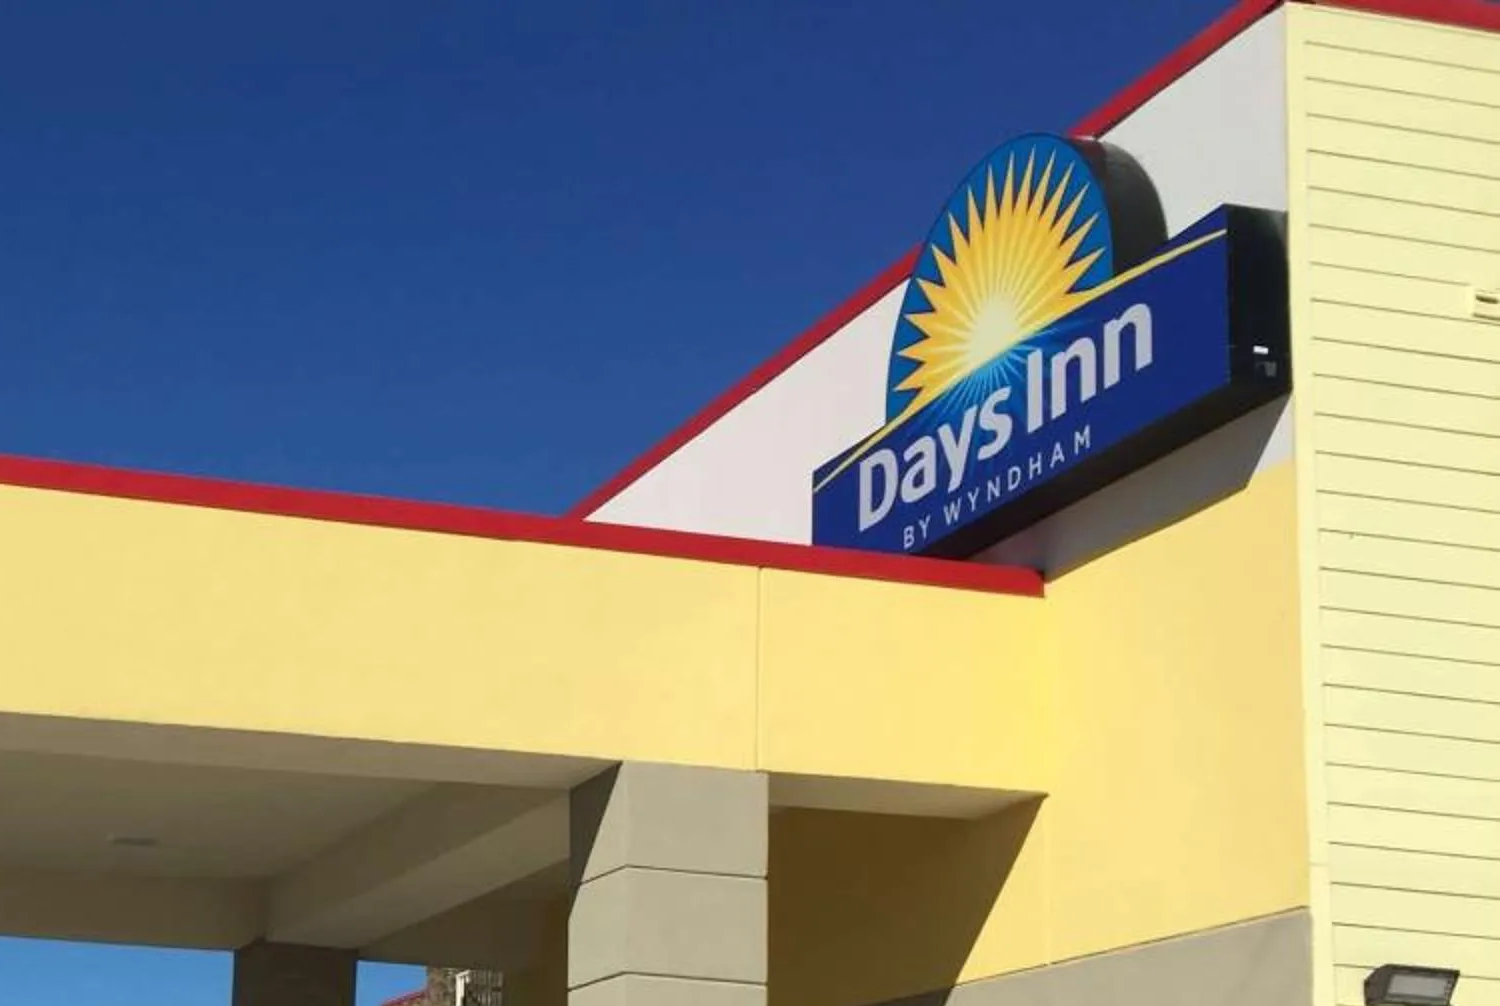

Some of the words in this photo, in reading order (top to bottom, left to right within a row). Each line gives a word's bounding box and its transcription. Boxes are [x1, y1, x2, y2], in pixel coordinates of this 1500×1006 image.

[859, 386, 1013, 532] Days
[1026, 303, 1153, 433] Inn
[903, 515, 931, 549] BY
[943, 425, 1091, 526] WYNDHAM
